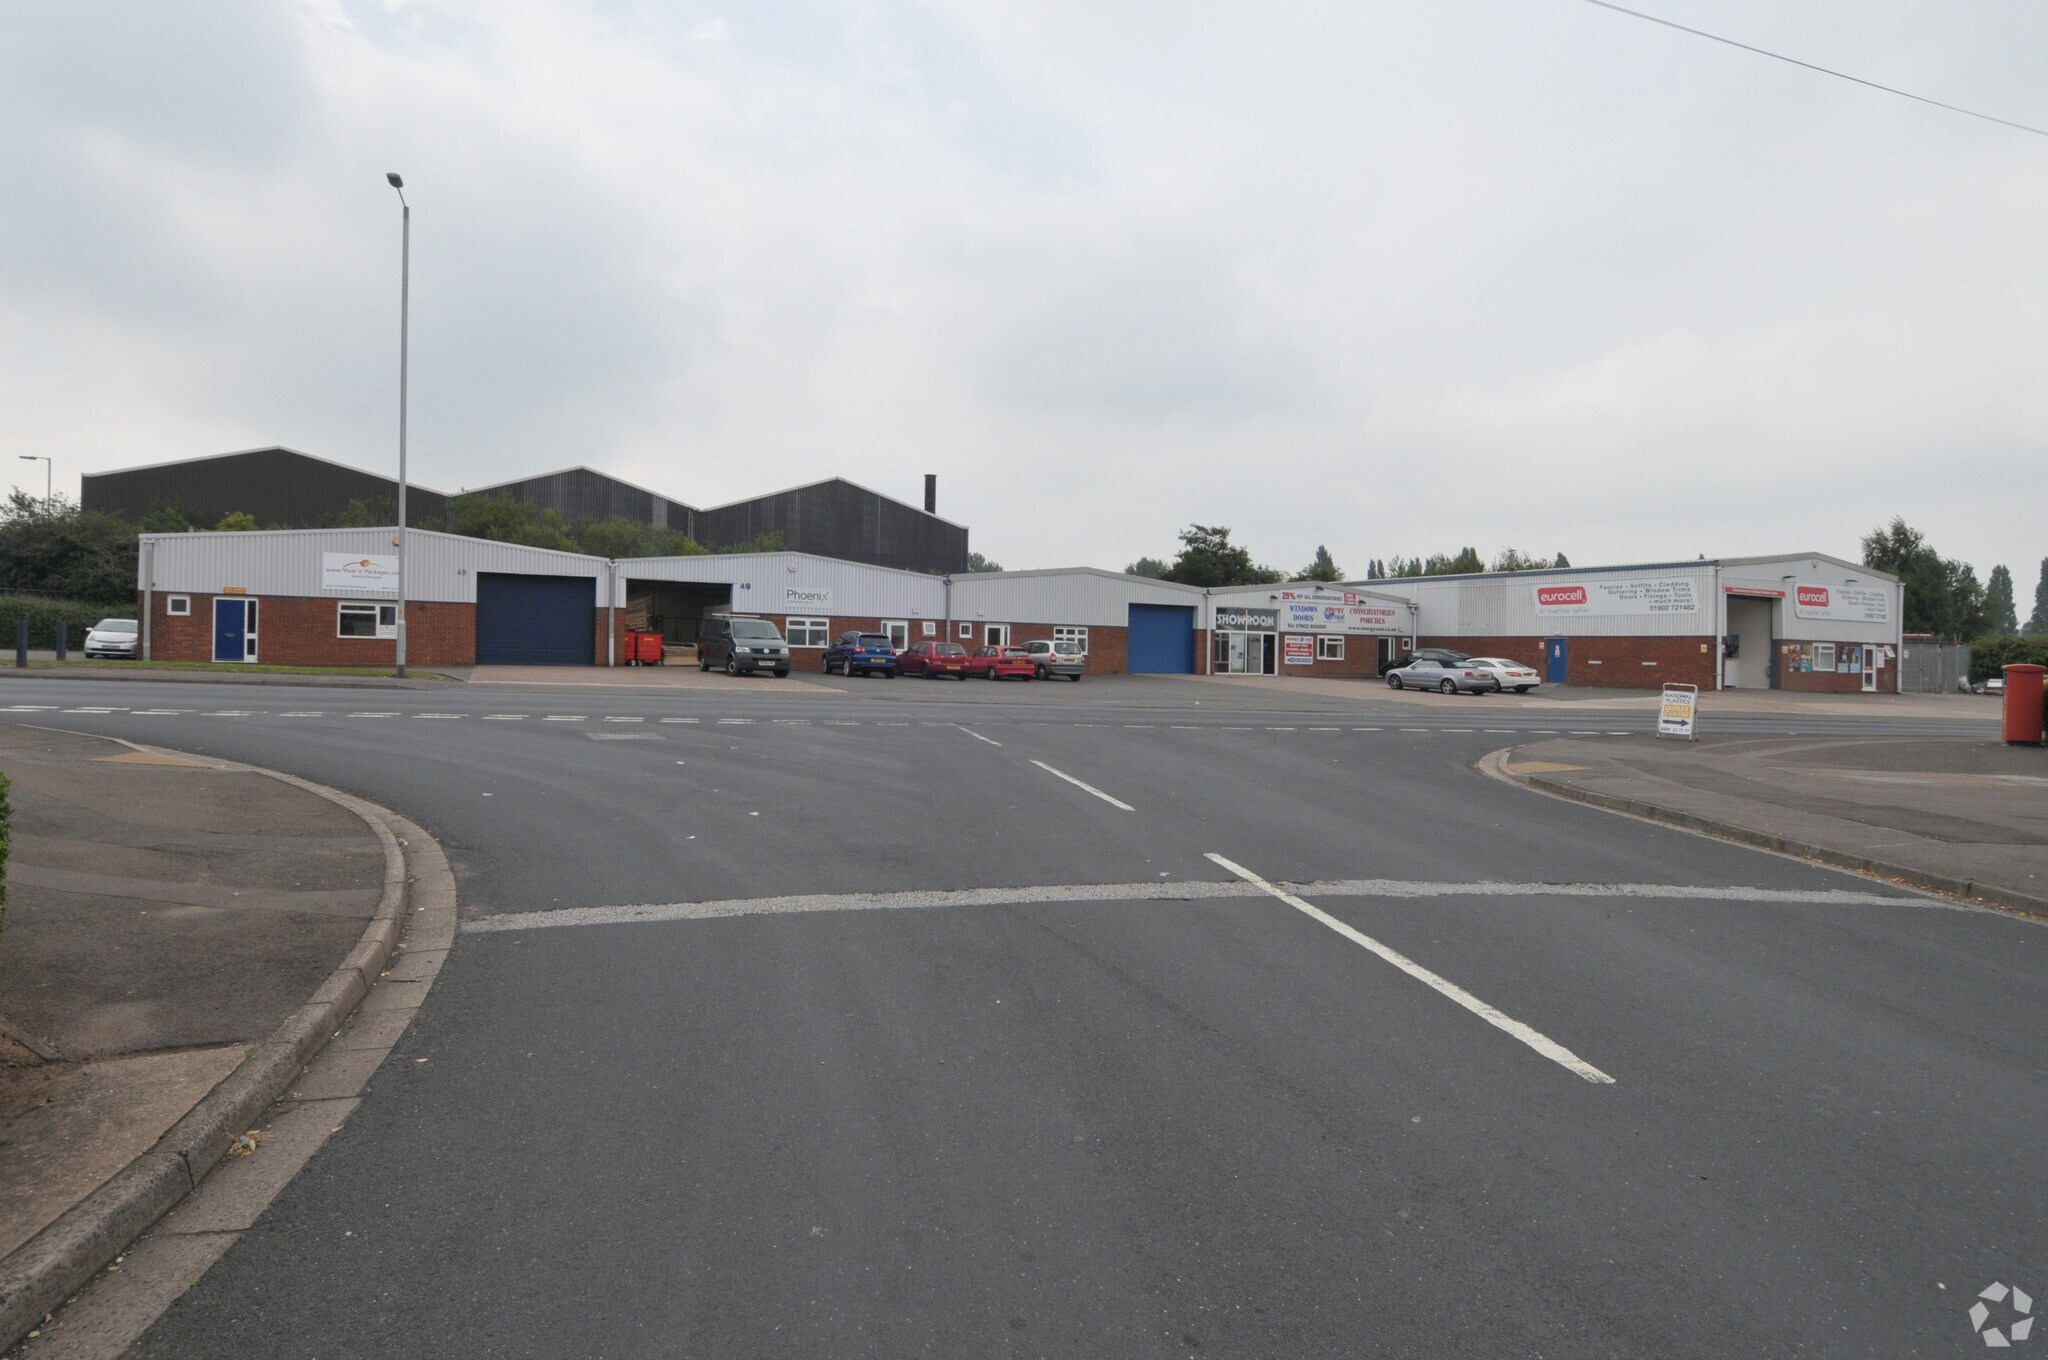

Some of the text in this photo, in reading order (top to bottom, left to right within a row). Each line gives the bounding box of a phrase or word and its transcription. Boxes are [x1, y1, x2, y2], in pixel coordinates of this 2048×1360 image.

[786, 589, 829, 601] Phoenix
[1282, 592, 1296, 600] 25%
[1541, 590, 1582, 601] eurocell
[1799, 592, 1827, 603] eurocell
[1349, 608, 1396, 616] CONSERVATORIES
[1217, 614, 1275, 626] SHOWROOM
